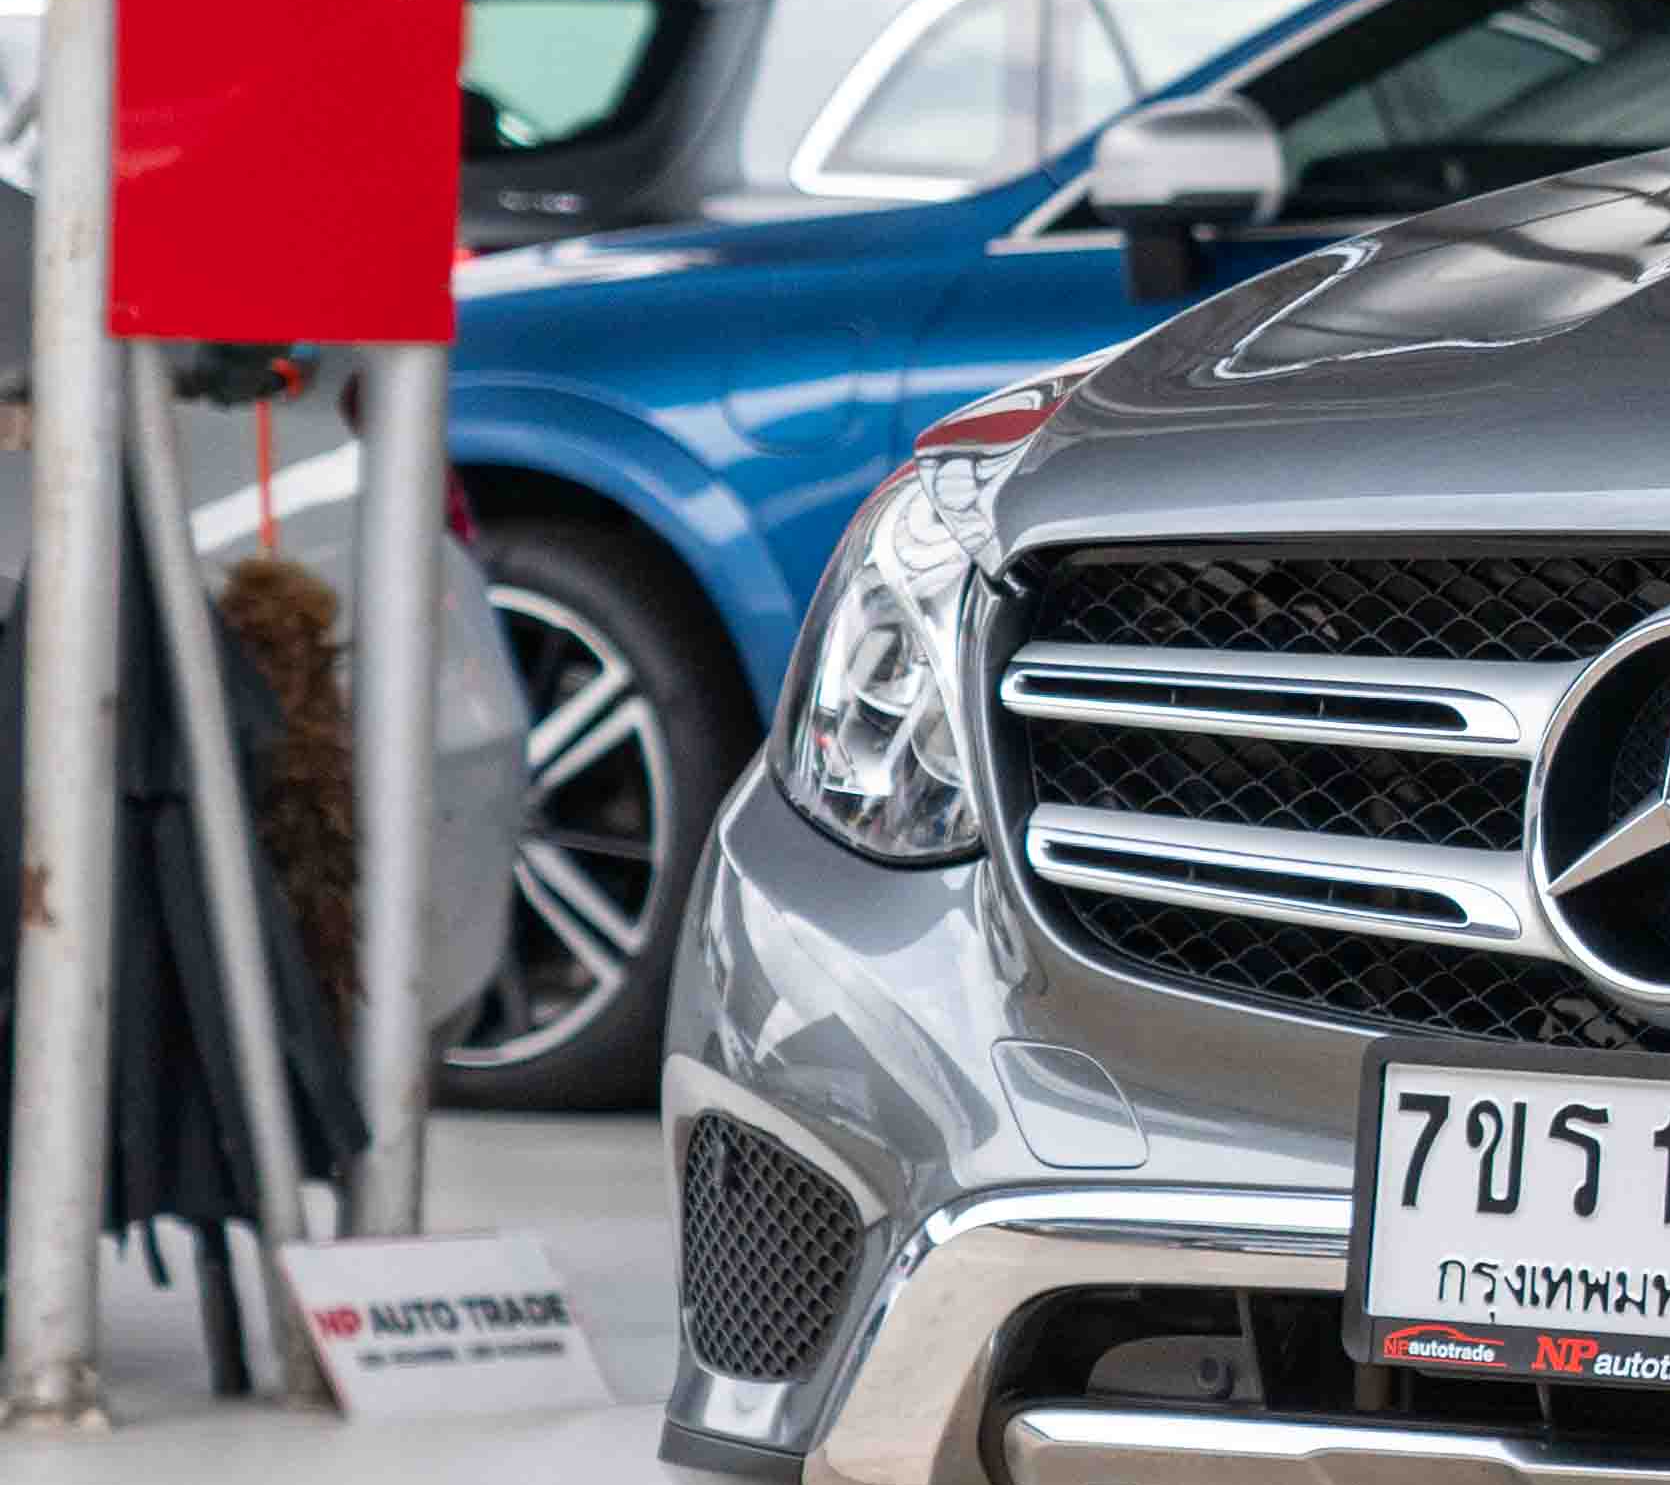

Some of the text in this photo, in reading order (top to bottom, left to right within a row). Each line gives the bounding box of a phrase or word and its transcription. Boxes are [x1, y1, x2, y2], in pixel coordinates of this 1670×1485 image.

[1399, 1093, 1609, 1217] 7ขร
[370, 1299, 460, 1335] AUTO
[462, 1291, 571, 1326] TRADE
